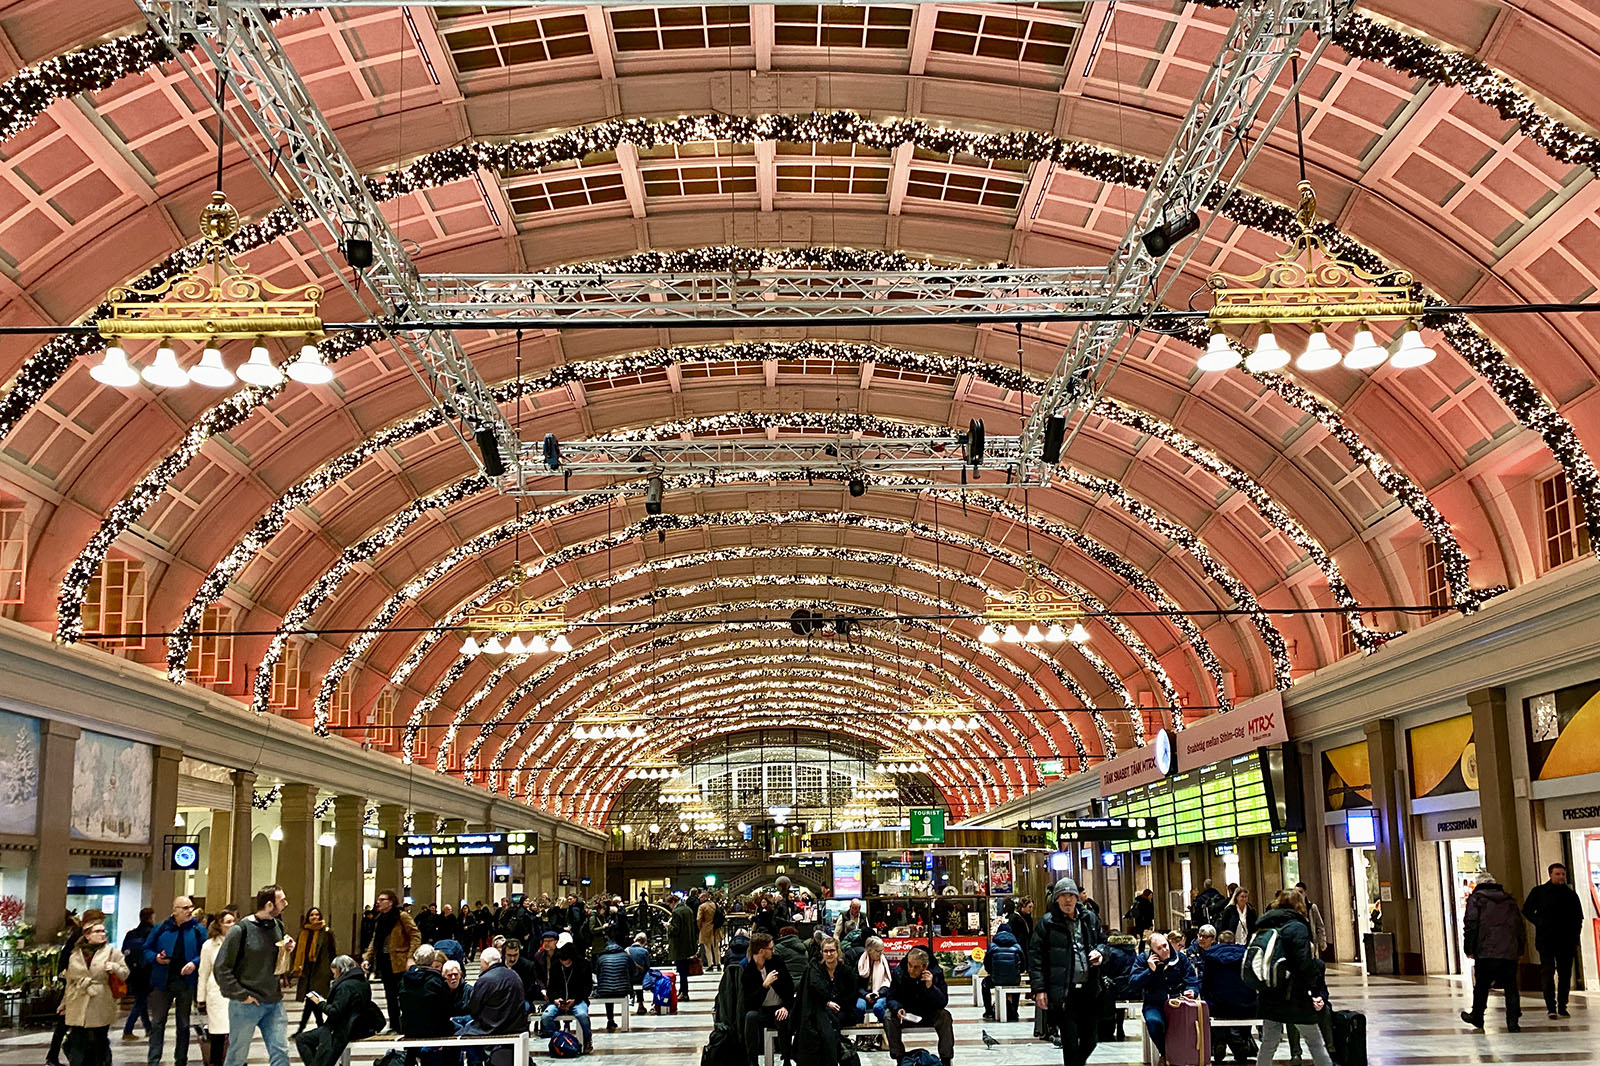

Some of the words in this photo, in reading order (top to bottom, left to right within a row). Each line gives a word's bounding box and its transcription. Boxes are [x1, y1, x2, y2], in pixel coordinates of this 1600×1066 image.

[1248, 712, 1275, 736] MTRX
[1206, 736, 1220, 748] mellan
[1104, 771, 1114, 785] TÄNK
[1131, 761, 1142, 776] TÄNK
[1142, 756, 1157, 772] MTRX
[1030, 821, 1052, 830] Utgång
[1078, 819, 1108, 828] Vasagatan
[1437, 818, 1478, 832] PRESSBYRÅN
[407, 836, 430, 845] Utgång
[431, 836, 444, 844] Way
[456, 835, 487, 844] Vasagatan
[488, 834, 501, 842] Taxi
[800, 838, 832, 849] TICKETS
[432, 847, 447, 855] Track
